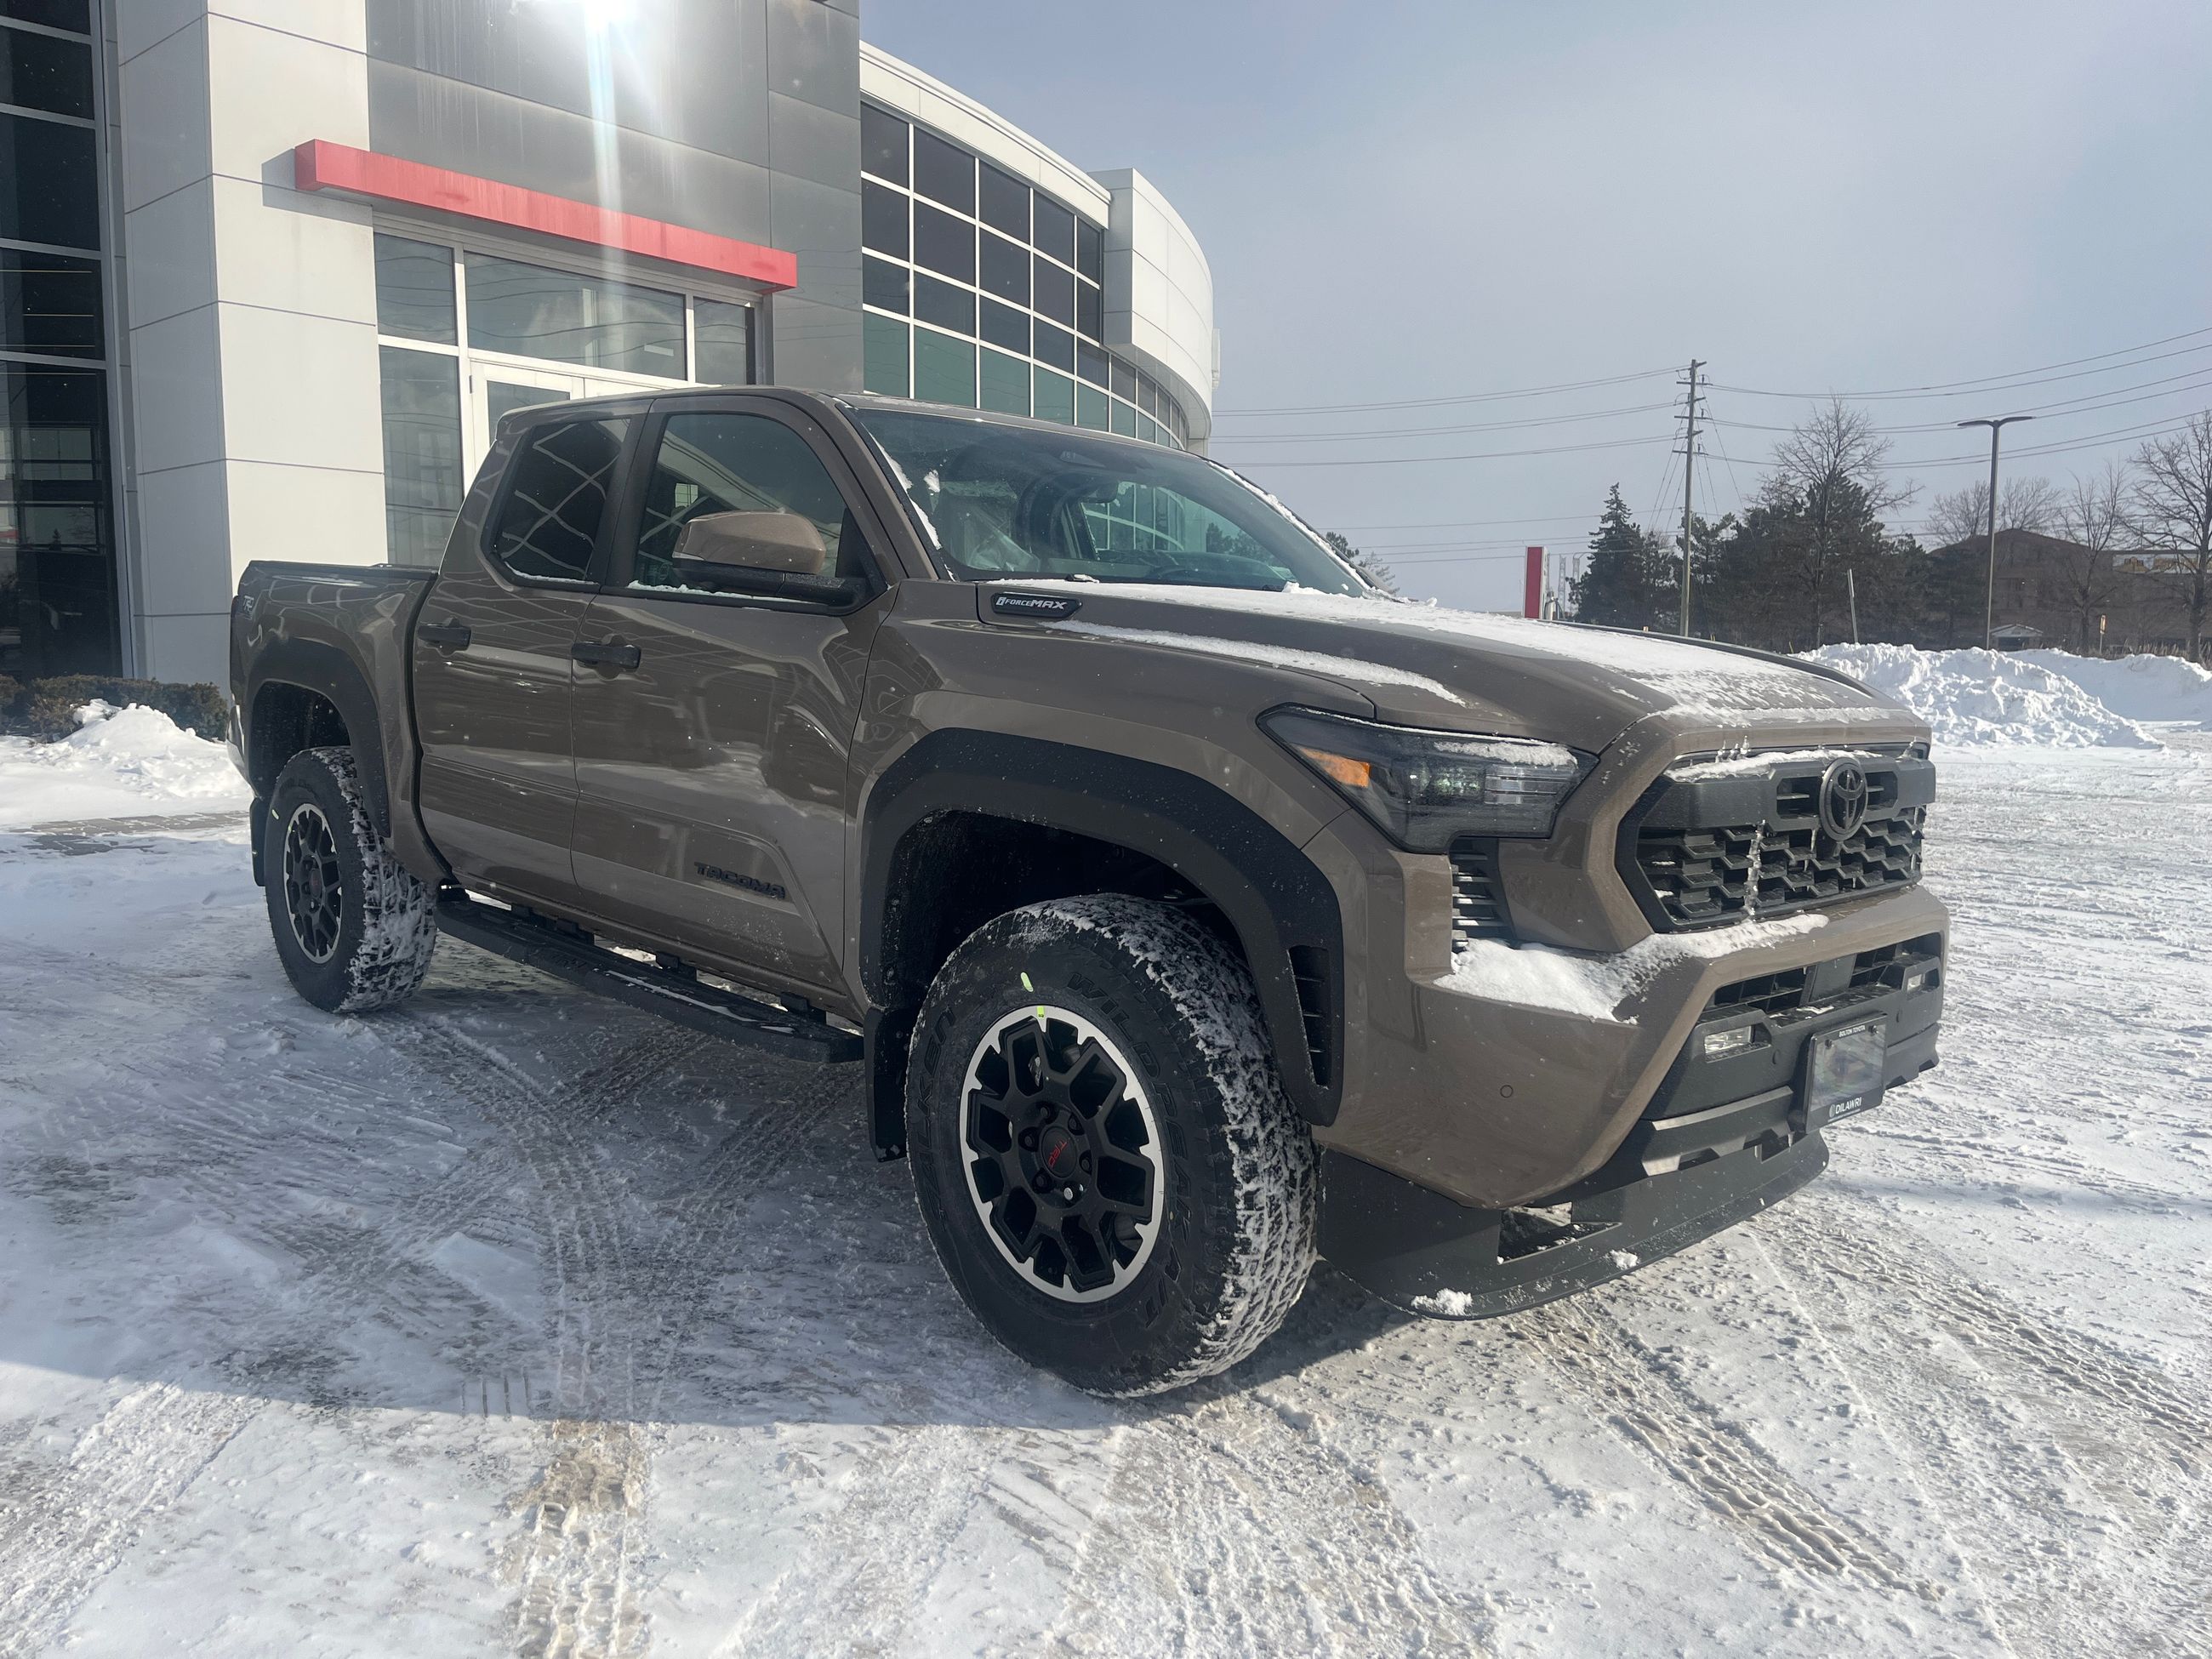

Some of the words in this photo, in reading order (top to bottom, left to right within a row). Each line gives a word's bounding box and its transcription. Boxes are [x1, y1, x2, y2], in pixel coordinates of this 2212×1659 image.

[694, 861, 786, 900] TACOMA
[1839, 1029, 1853, 1038] BOLTON
[1852, 1024, 1866, 1034] TOYOTA
[1835, 1097, 1862, 1115] DILAWRI
[1047, 1138, 1069, 1168] TRD
